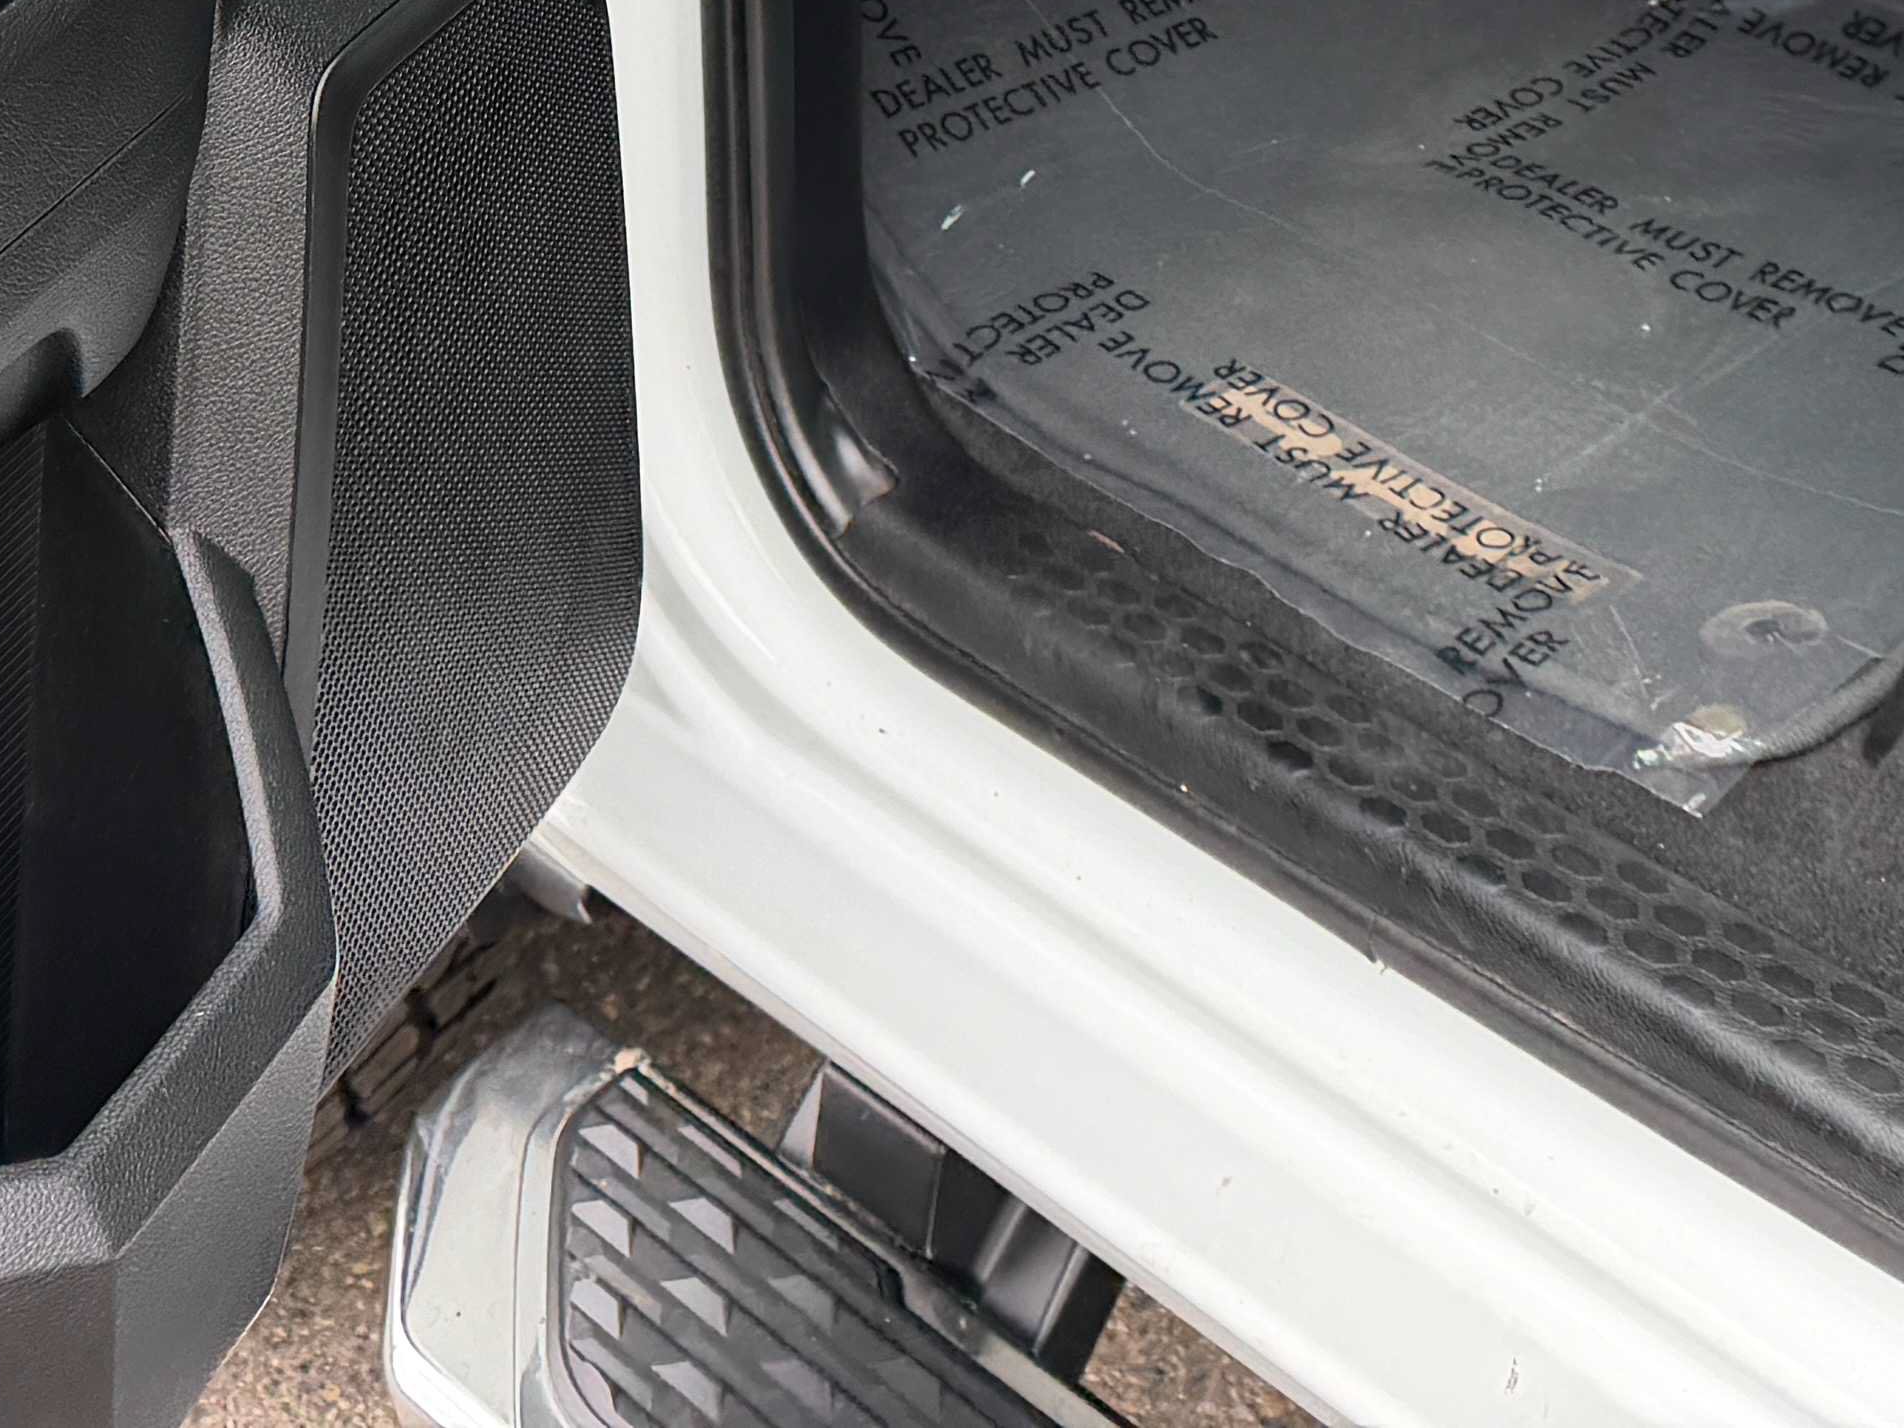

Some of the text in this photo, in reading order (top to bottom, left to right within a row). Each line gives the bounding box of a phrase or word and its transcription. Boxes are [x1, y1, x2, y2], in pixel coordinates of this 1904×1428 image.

[869, 50, 1003, 120] DEALER
[1014, 9, 1109, 68] MUST
[898, 16, 1219, 158] PROTECTIVE COVER
[1452, 76, 1564, 132] COVER
[1566, 61, 1657, 114] MUST
[1736, 6, 1891, 89] REMOVE
[1455, 165, 1798, 329] PROTECTIVE COVER
[1489, 153, 1620, 217] DEALER
[1628, 216, 1745, 270] MUST
[1004, 289, 1151, 366] DEALER
[1096, 330, 1526, 594] DEALER MUST REMOVE
[1213, 357, 1542, 568] PROTECTIVE COVER
